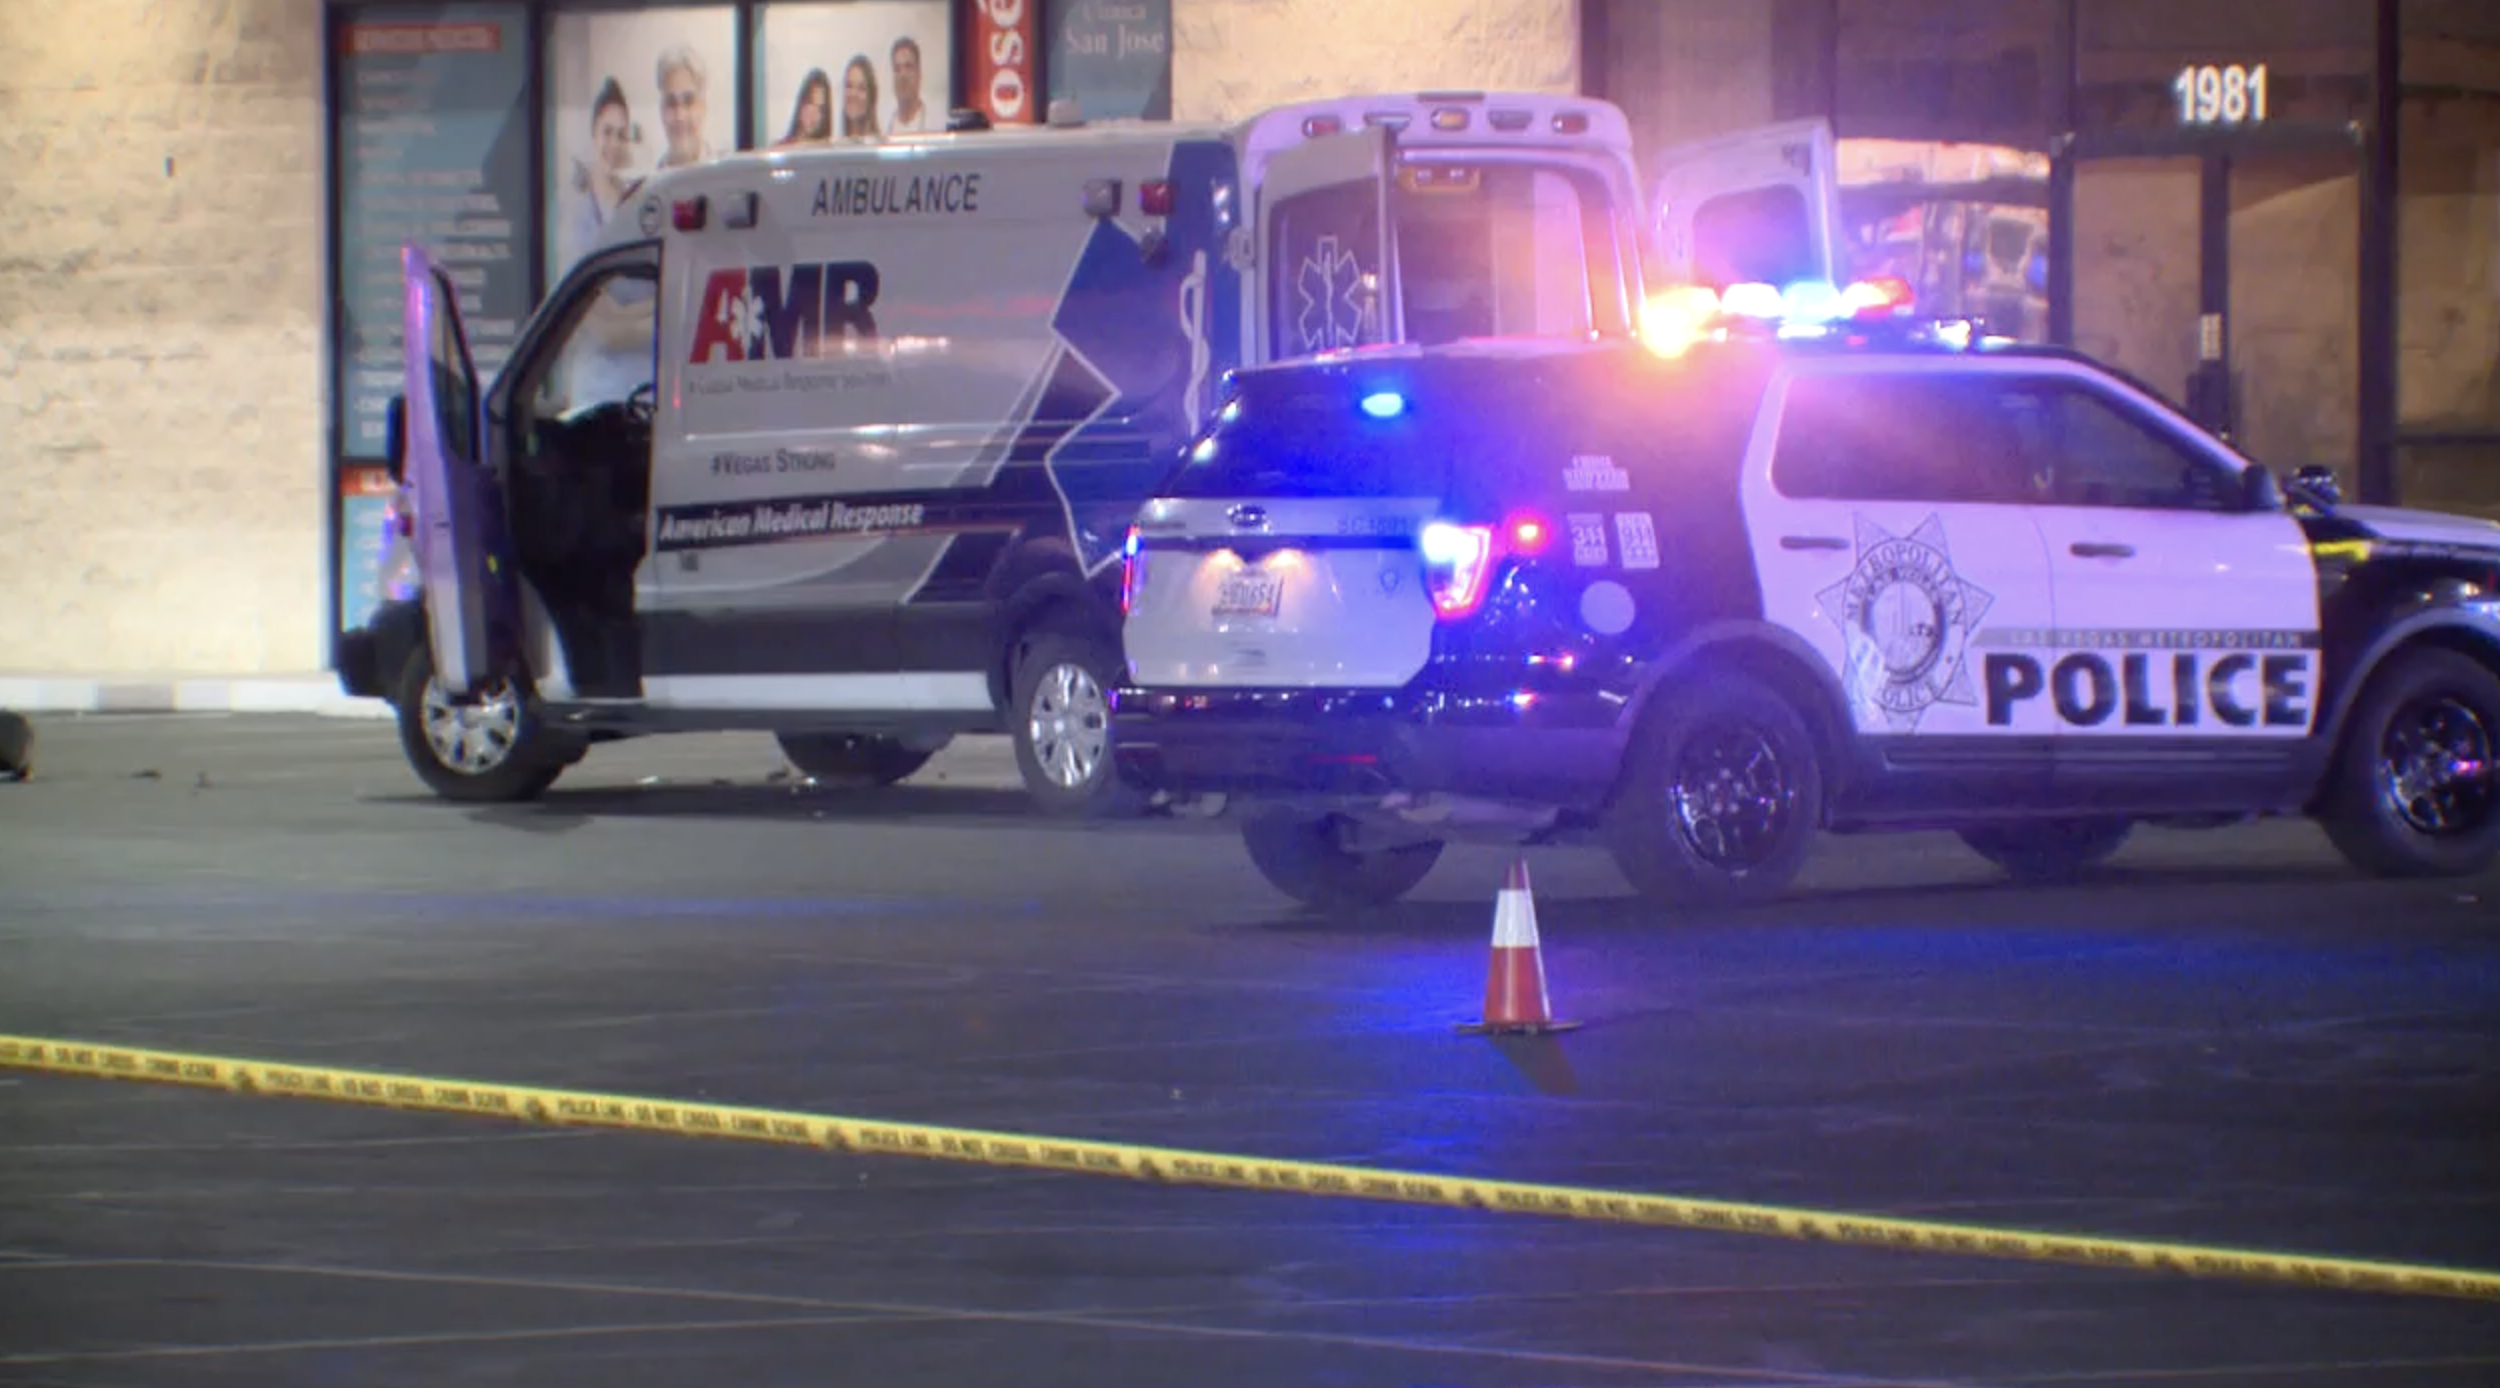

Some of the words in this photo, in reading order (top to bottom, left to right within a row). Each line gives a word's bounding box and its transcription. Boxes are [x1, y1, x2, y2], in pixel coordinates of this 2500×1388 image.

[2175, 64, 2267, 122] 1981
[811, 173, 981, 217] AMBULANCE
[689, 260, 881, 365] AMR
[660, 509, 750, 541] American
[754, 503, 828, 534] Medical
[831, 501, 924, 535] Response
[2141, 631, 2302, 648] METROPOLITAN
[1984, 653, 2308, 727] POLICE
